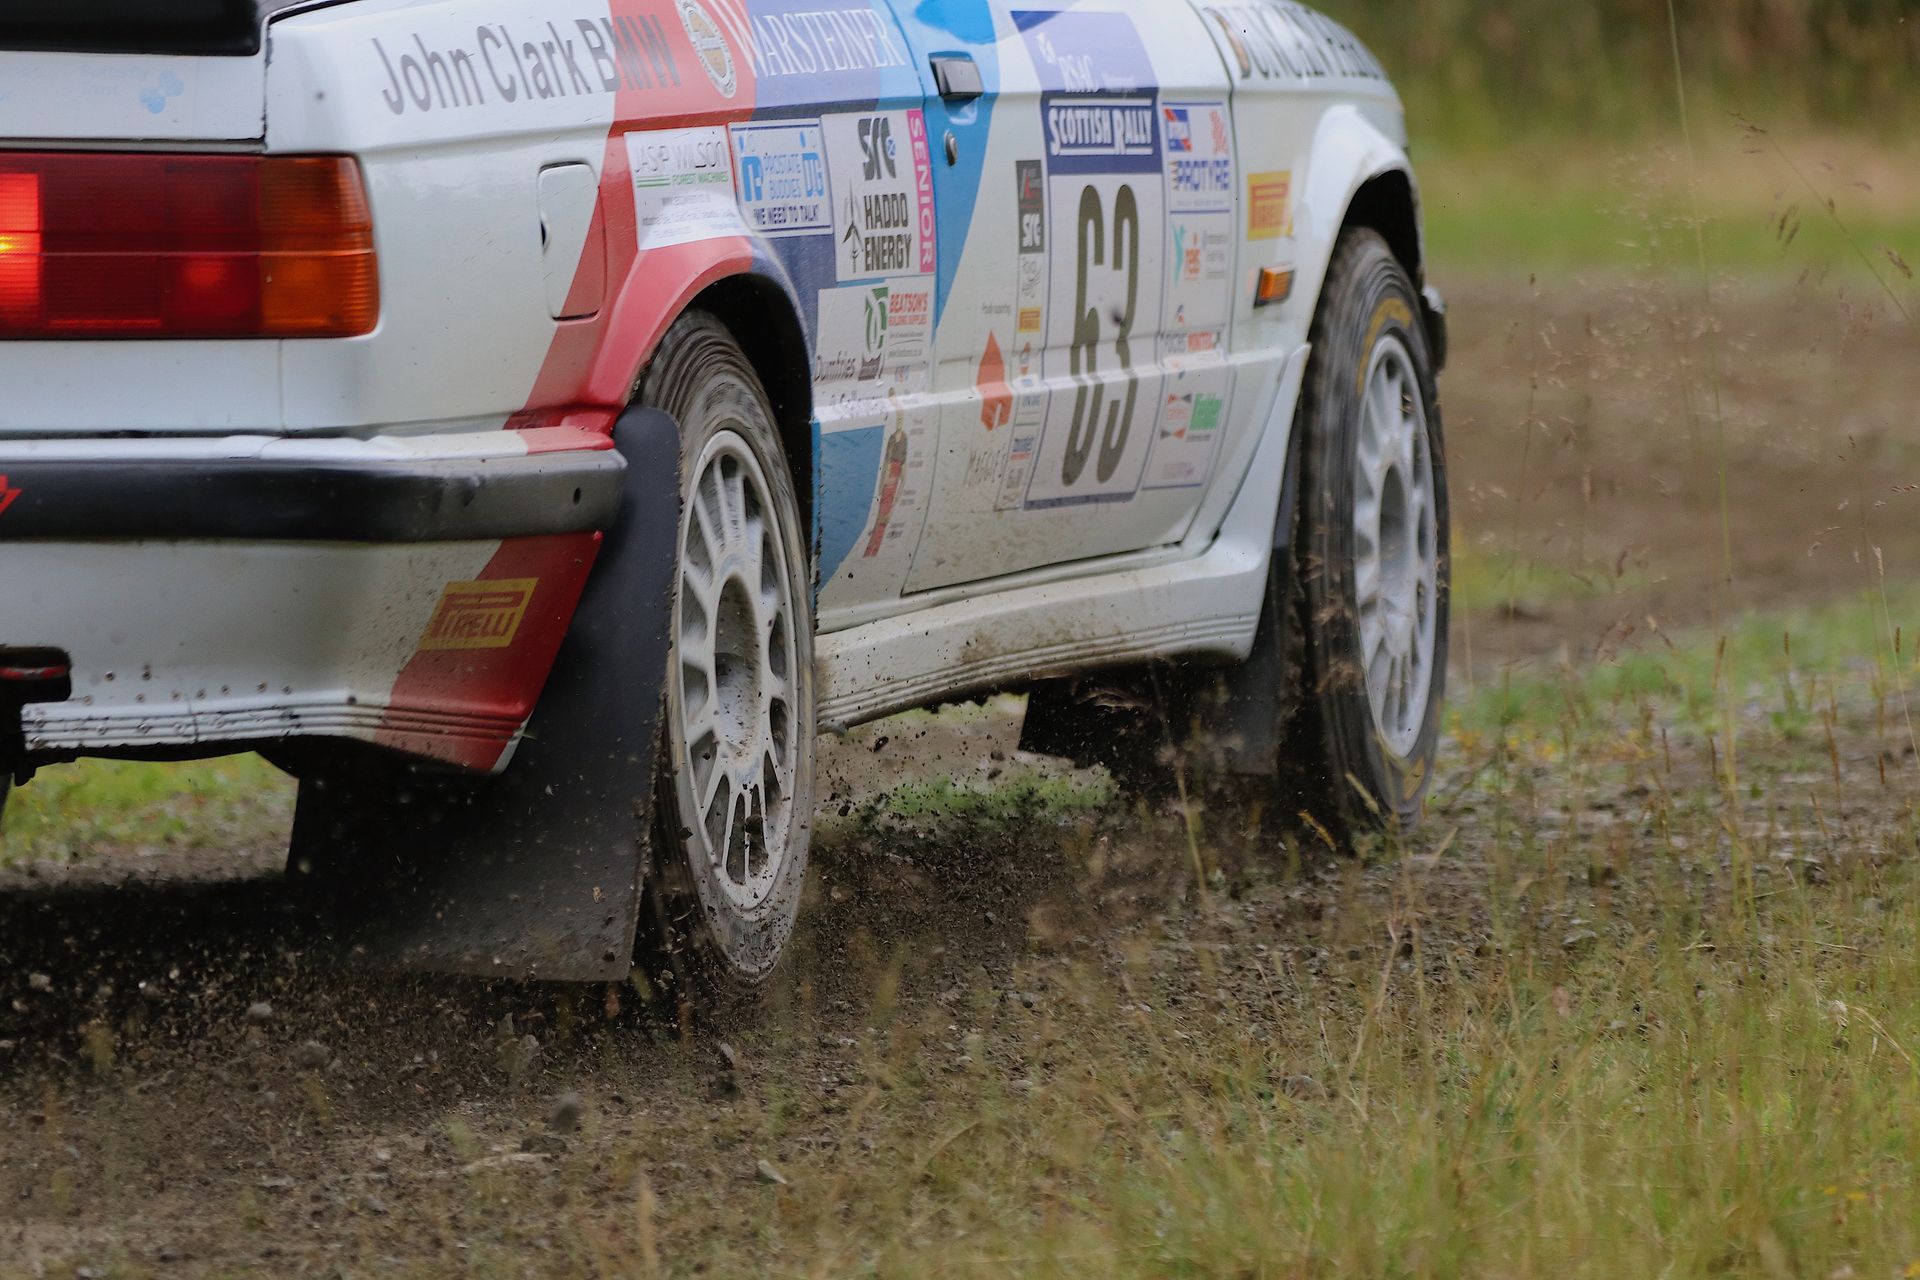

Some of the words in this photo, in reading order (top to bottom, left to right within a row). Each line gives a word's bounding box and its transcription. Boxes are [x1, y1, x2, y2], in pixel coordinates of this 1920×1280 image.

[709, 0, 906, 78] WARSTEINER
[371, 32, 485, 115] John
[477, 21, 592, 103] Clark
[574, 14, 682, 93] BMW
[1049, 107, 1113, 156] SCOTTISH
[1111, 108, 1153, 155] RALLY
[909, 115, 936, 266] SENIOR
[1177, 159, 1230, 193] PROTYRE
[767, 205, 787, 224] NEED
[787, 204, 799, 223] TO
[863, 192, 910, 231] HADDO
[864, 234, 913, 272] ENERGY
[888, 292, 929, 314] BEATSON'S
[1061, 184, 1139, 487] 63
[812, 350, 857, 383] Dumfries
[430, 590, 526, 638] PIRELLI
